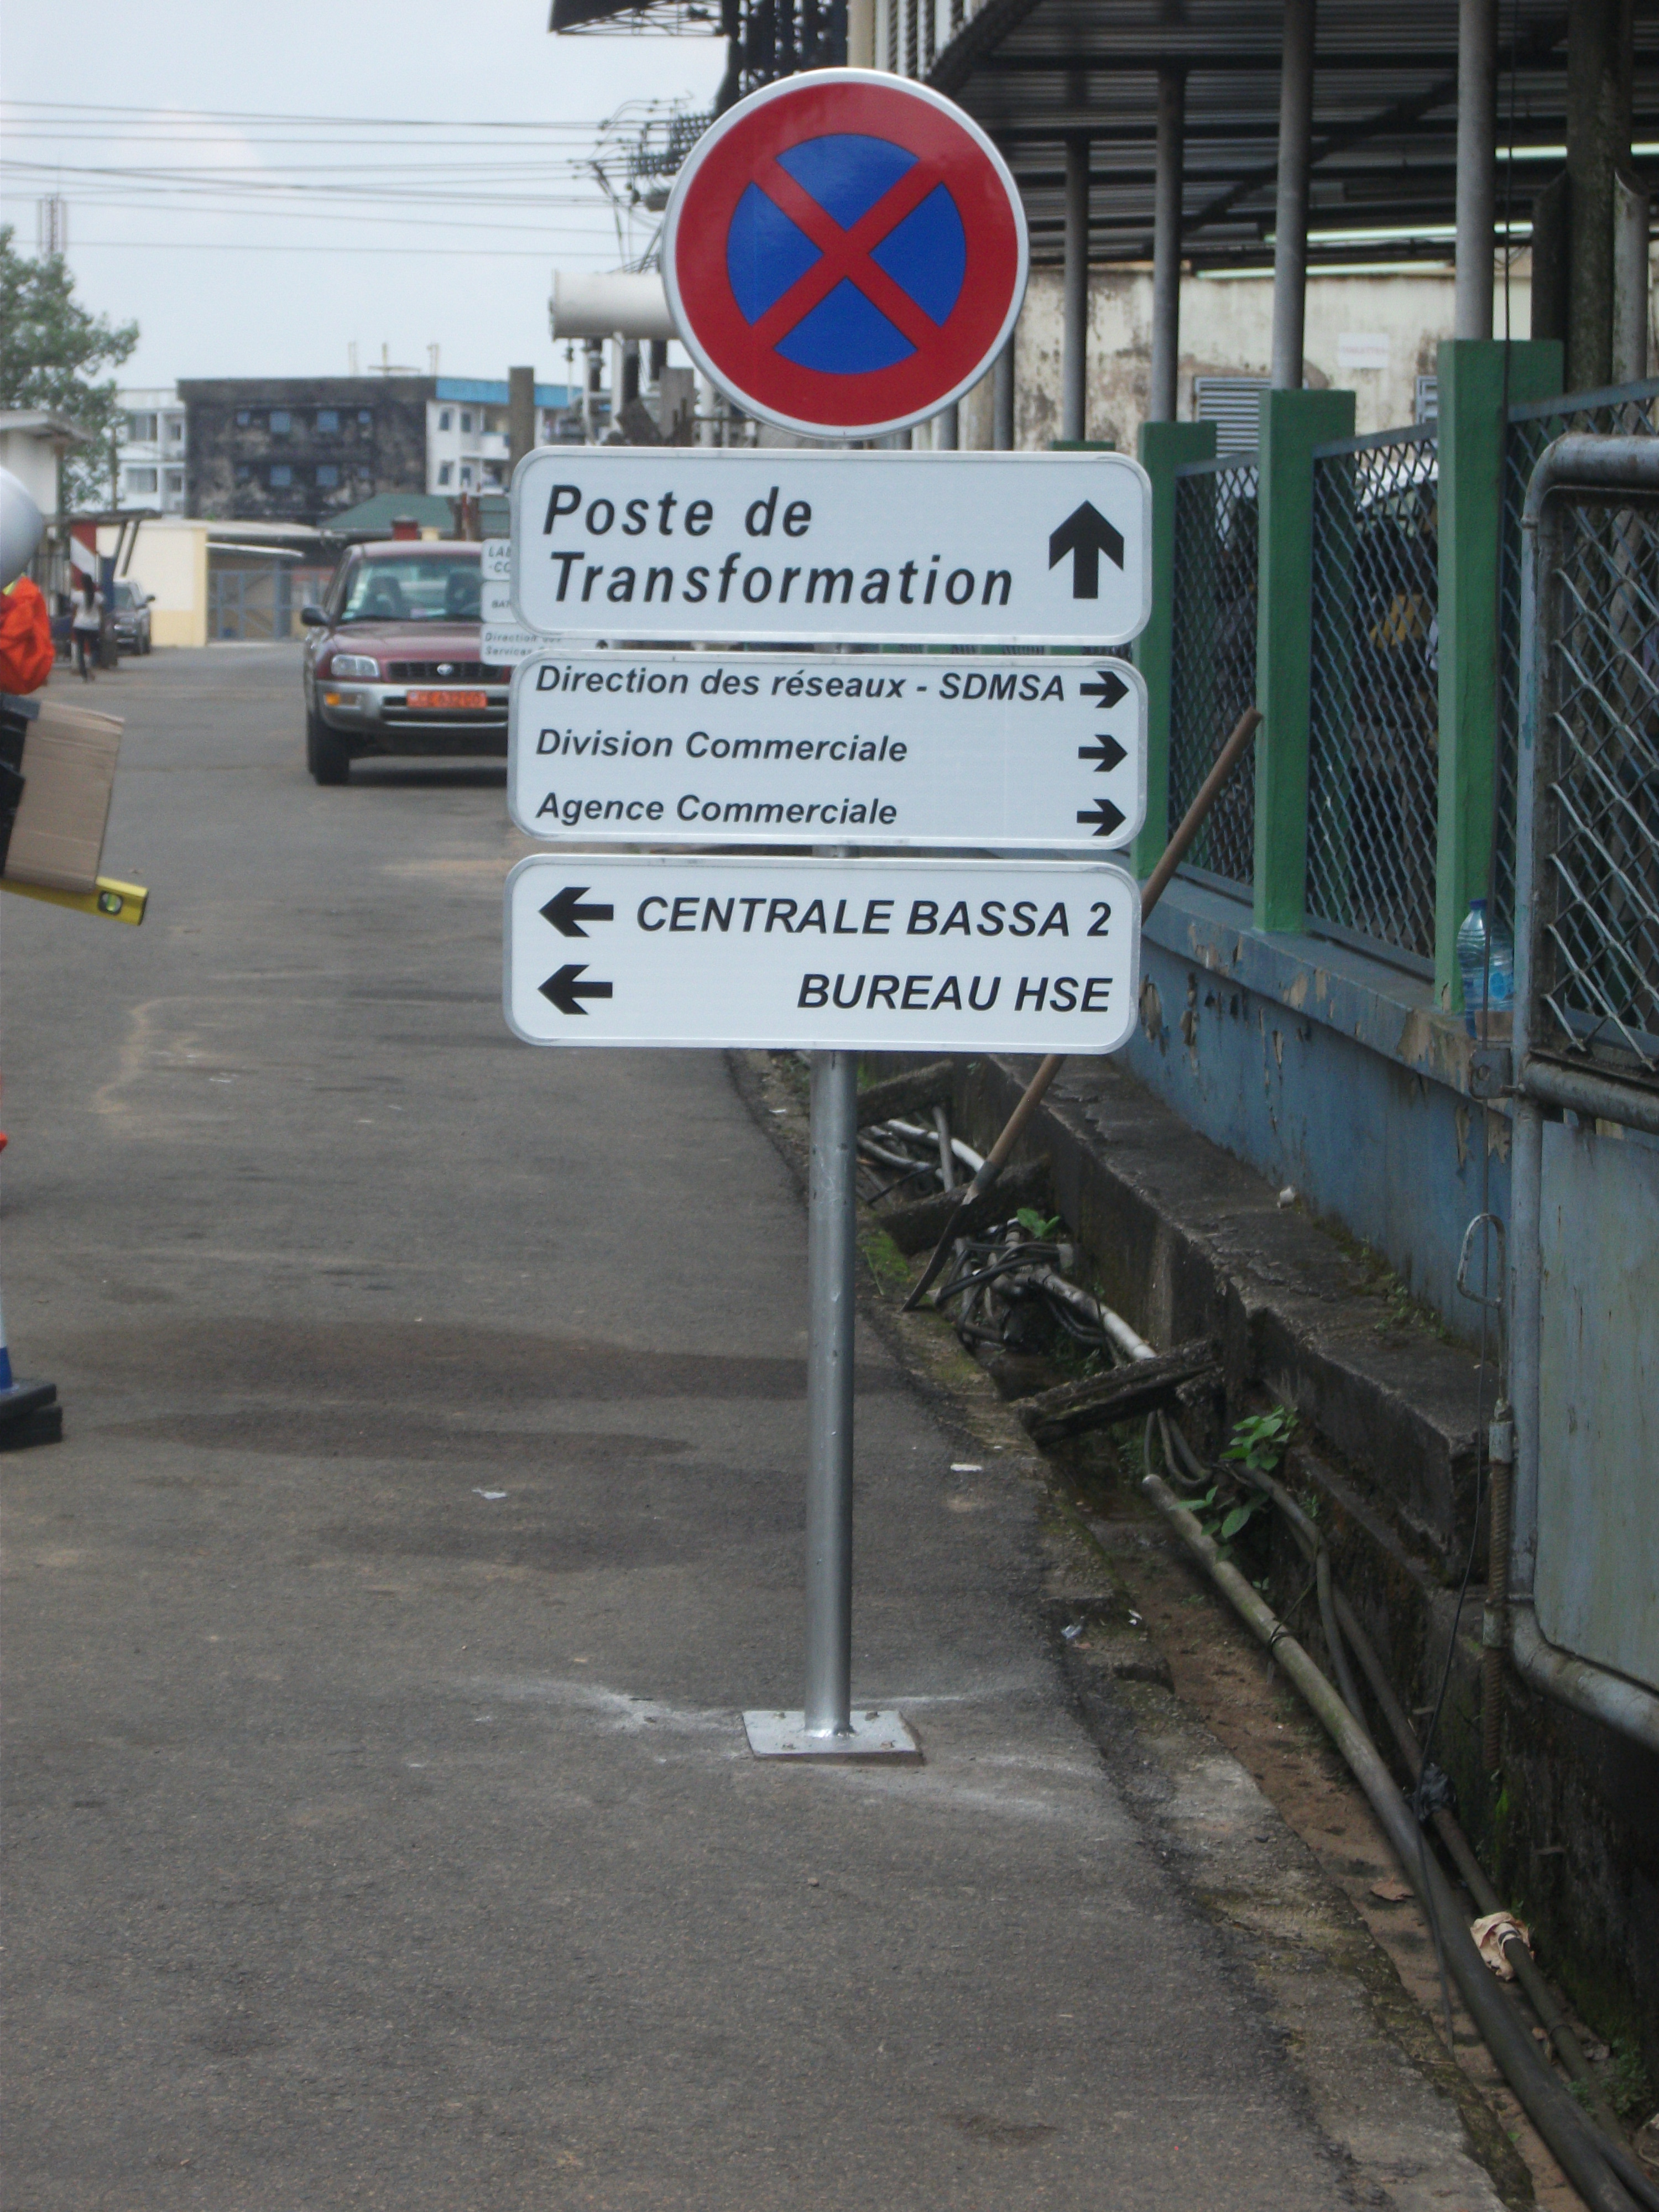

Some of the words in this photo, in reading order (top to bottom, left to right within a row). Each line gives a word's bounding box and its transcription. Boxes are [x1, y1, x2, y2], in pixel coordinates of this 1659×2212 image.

[544, 484, 713, 536] Poste
[745, 486, 812, 537] de
[551, 552, 1012, 606] Transformation
[536, 665, 688, 694] Direction
[701, 669, 759, 696] des
[771, 670, 906, 698] réseaux
[939, 672, 1065, 701] SDMSA
[536, 729, 672, 758] Division
[686, 731, 907, 762] Commerciale
[536, 792, 664, 826] Agence
[677, 795, 898, 825] Commerciale
[637, 896, 894, 935] CENTRALE
[906, 900, 1070, 937] BASSA
[1087, 902, 1111, 936] 2
[797, 974, 1001, 1011] BUREAU
[1014, 977, 1113, 1012] HSE
